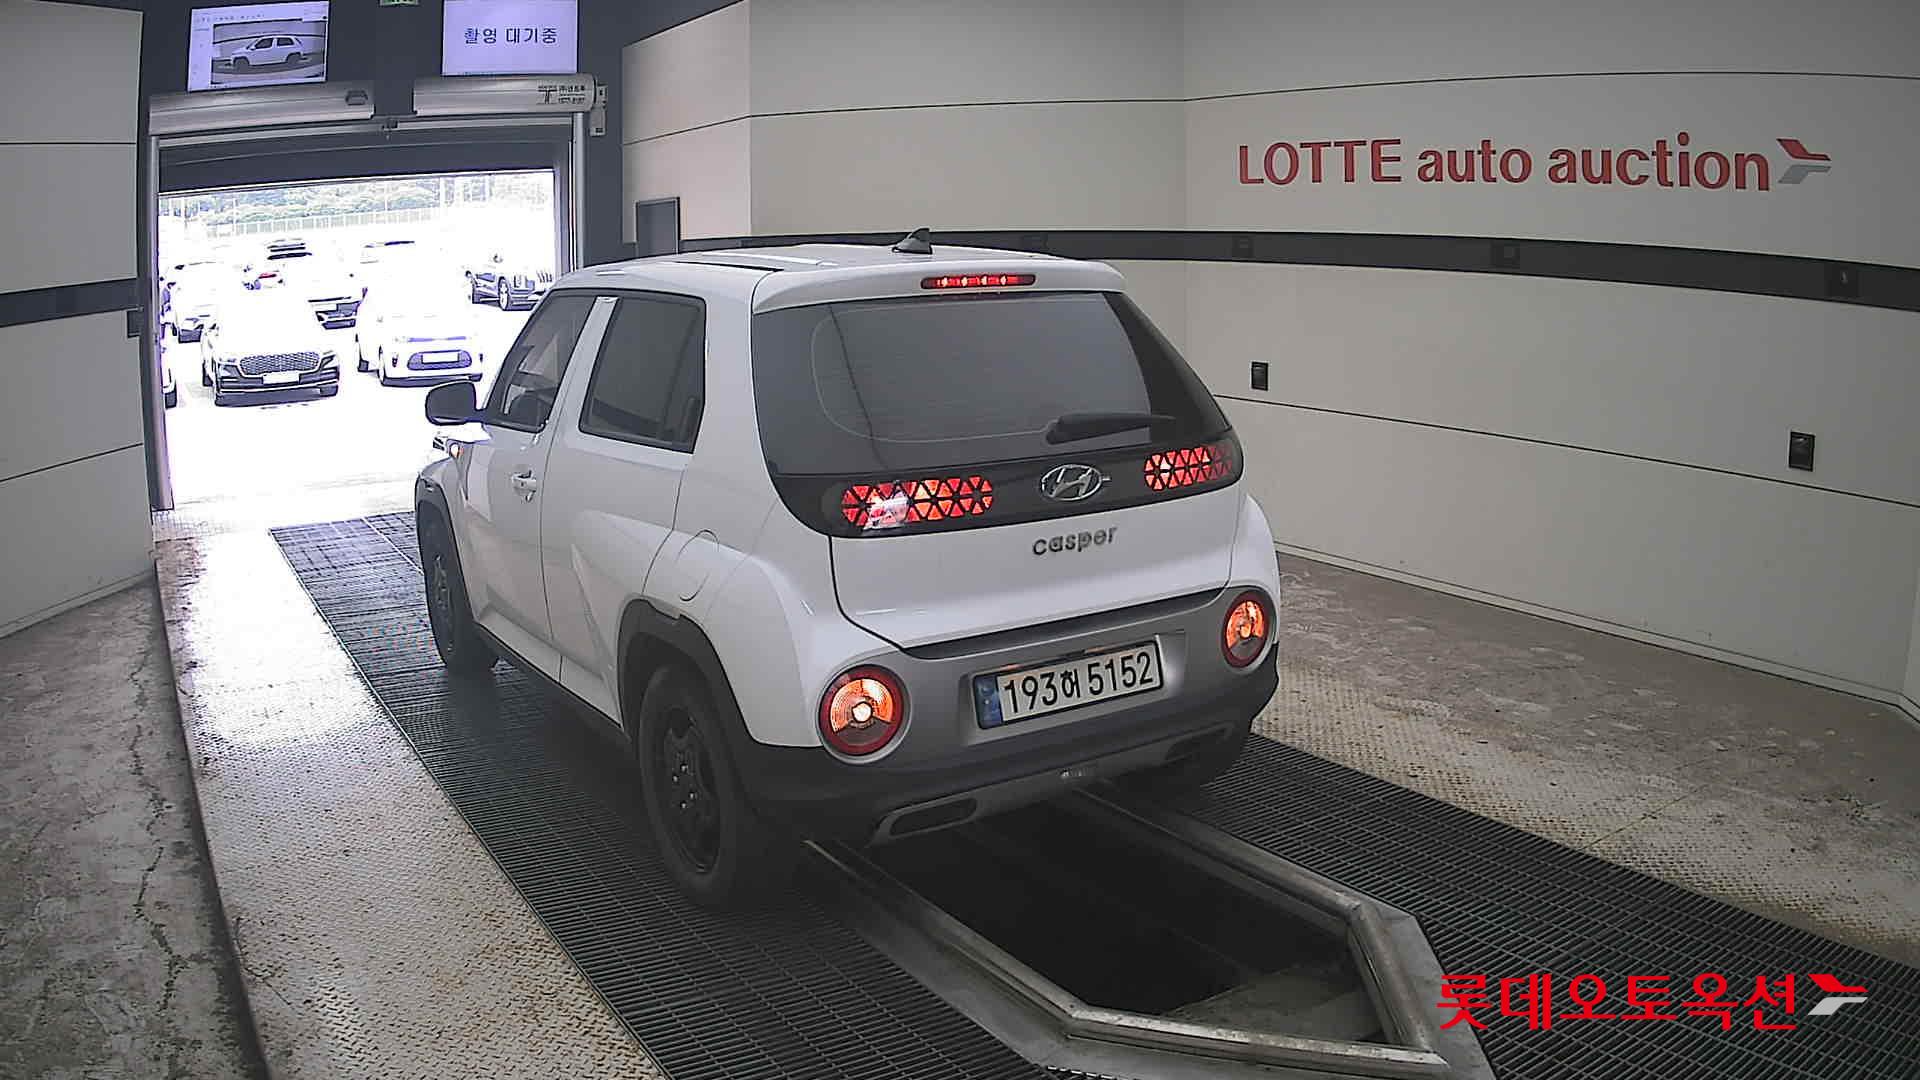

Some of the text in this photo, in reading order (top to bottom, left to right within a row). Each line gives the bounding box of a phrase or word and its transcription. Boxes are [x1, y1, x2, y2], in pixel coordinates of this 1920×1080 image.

[464, 27, 558, 45] 촬영 대기중
[1239, 131, 1771, 191] LOTTE auto auction
[1032, 526, 1118, 556] casper
[1003, 651, 1154, 714] 193허 5152
